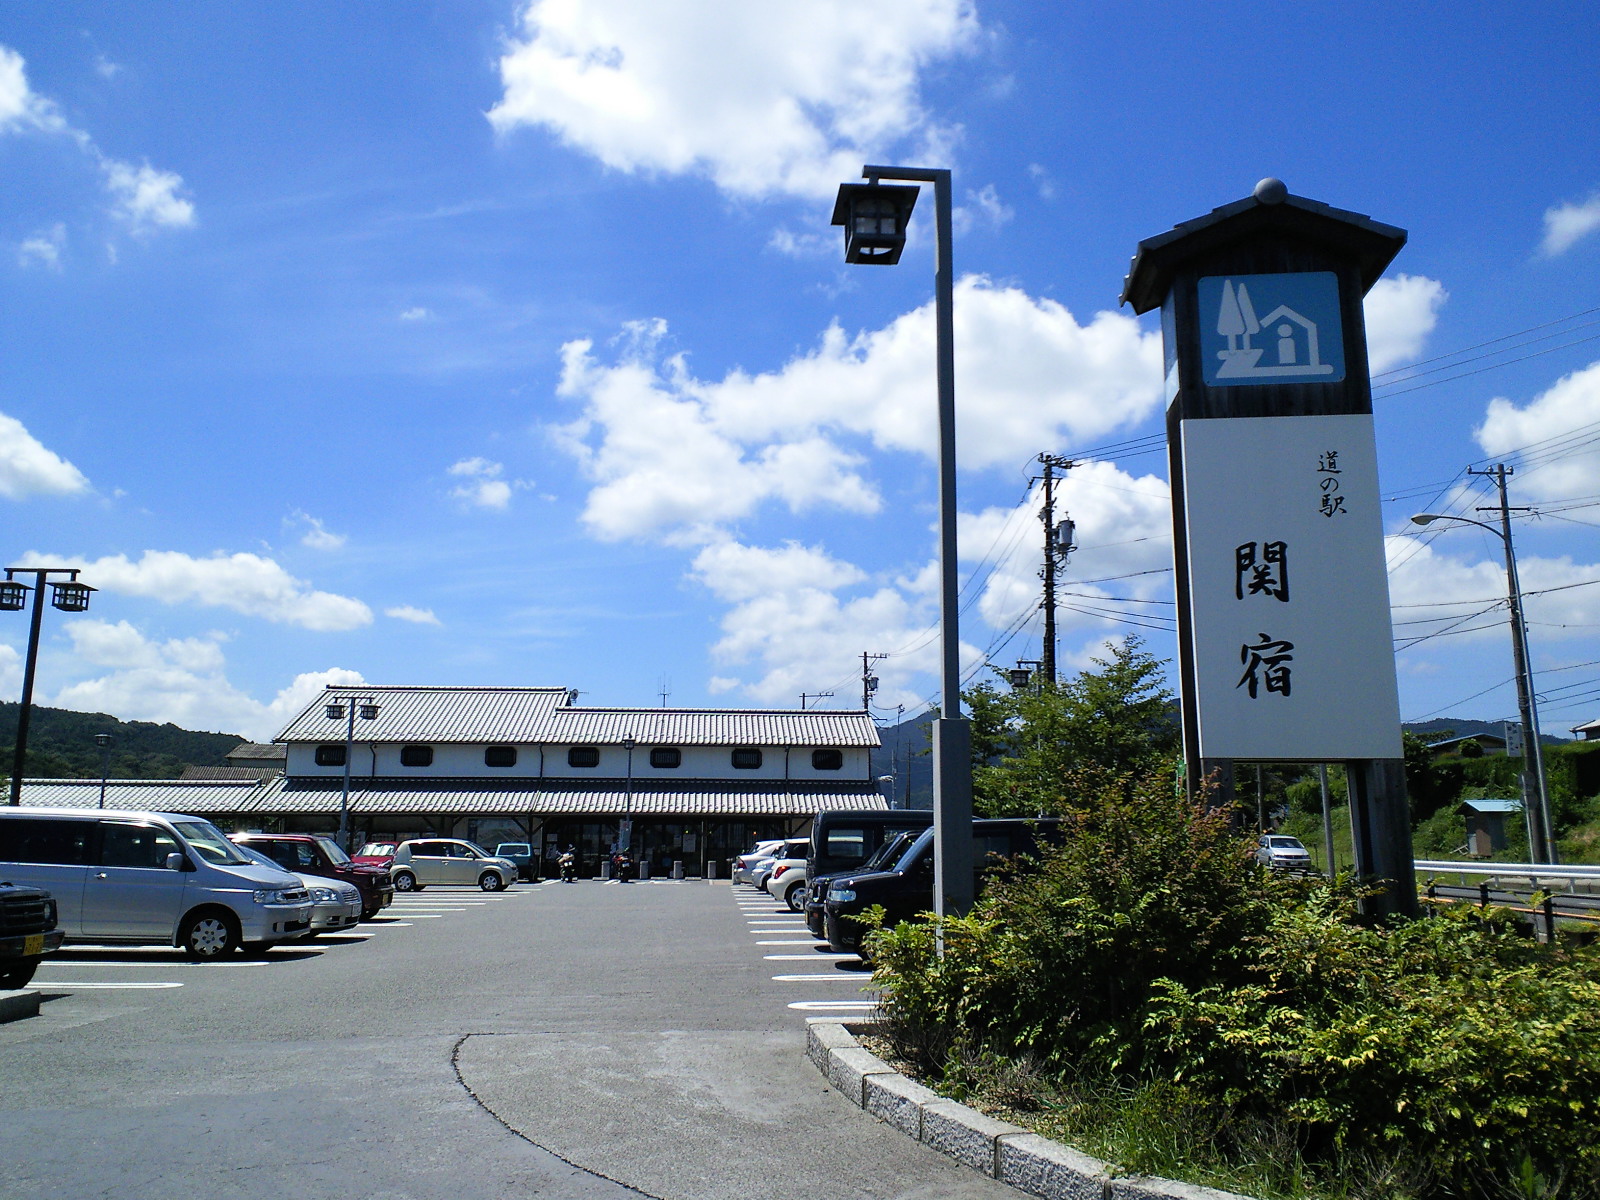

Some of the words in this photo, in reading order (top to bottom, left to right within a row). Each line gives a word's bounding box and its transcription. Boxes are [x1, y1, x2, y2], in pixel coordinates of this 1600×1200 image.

[1317, 450, 1347, 518] 道の駅
[1235, 541, 1294, 699] 関宿
